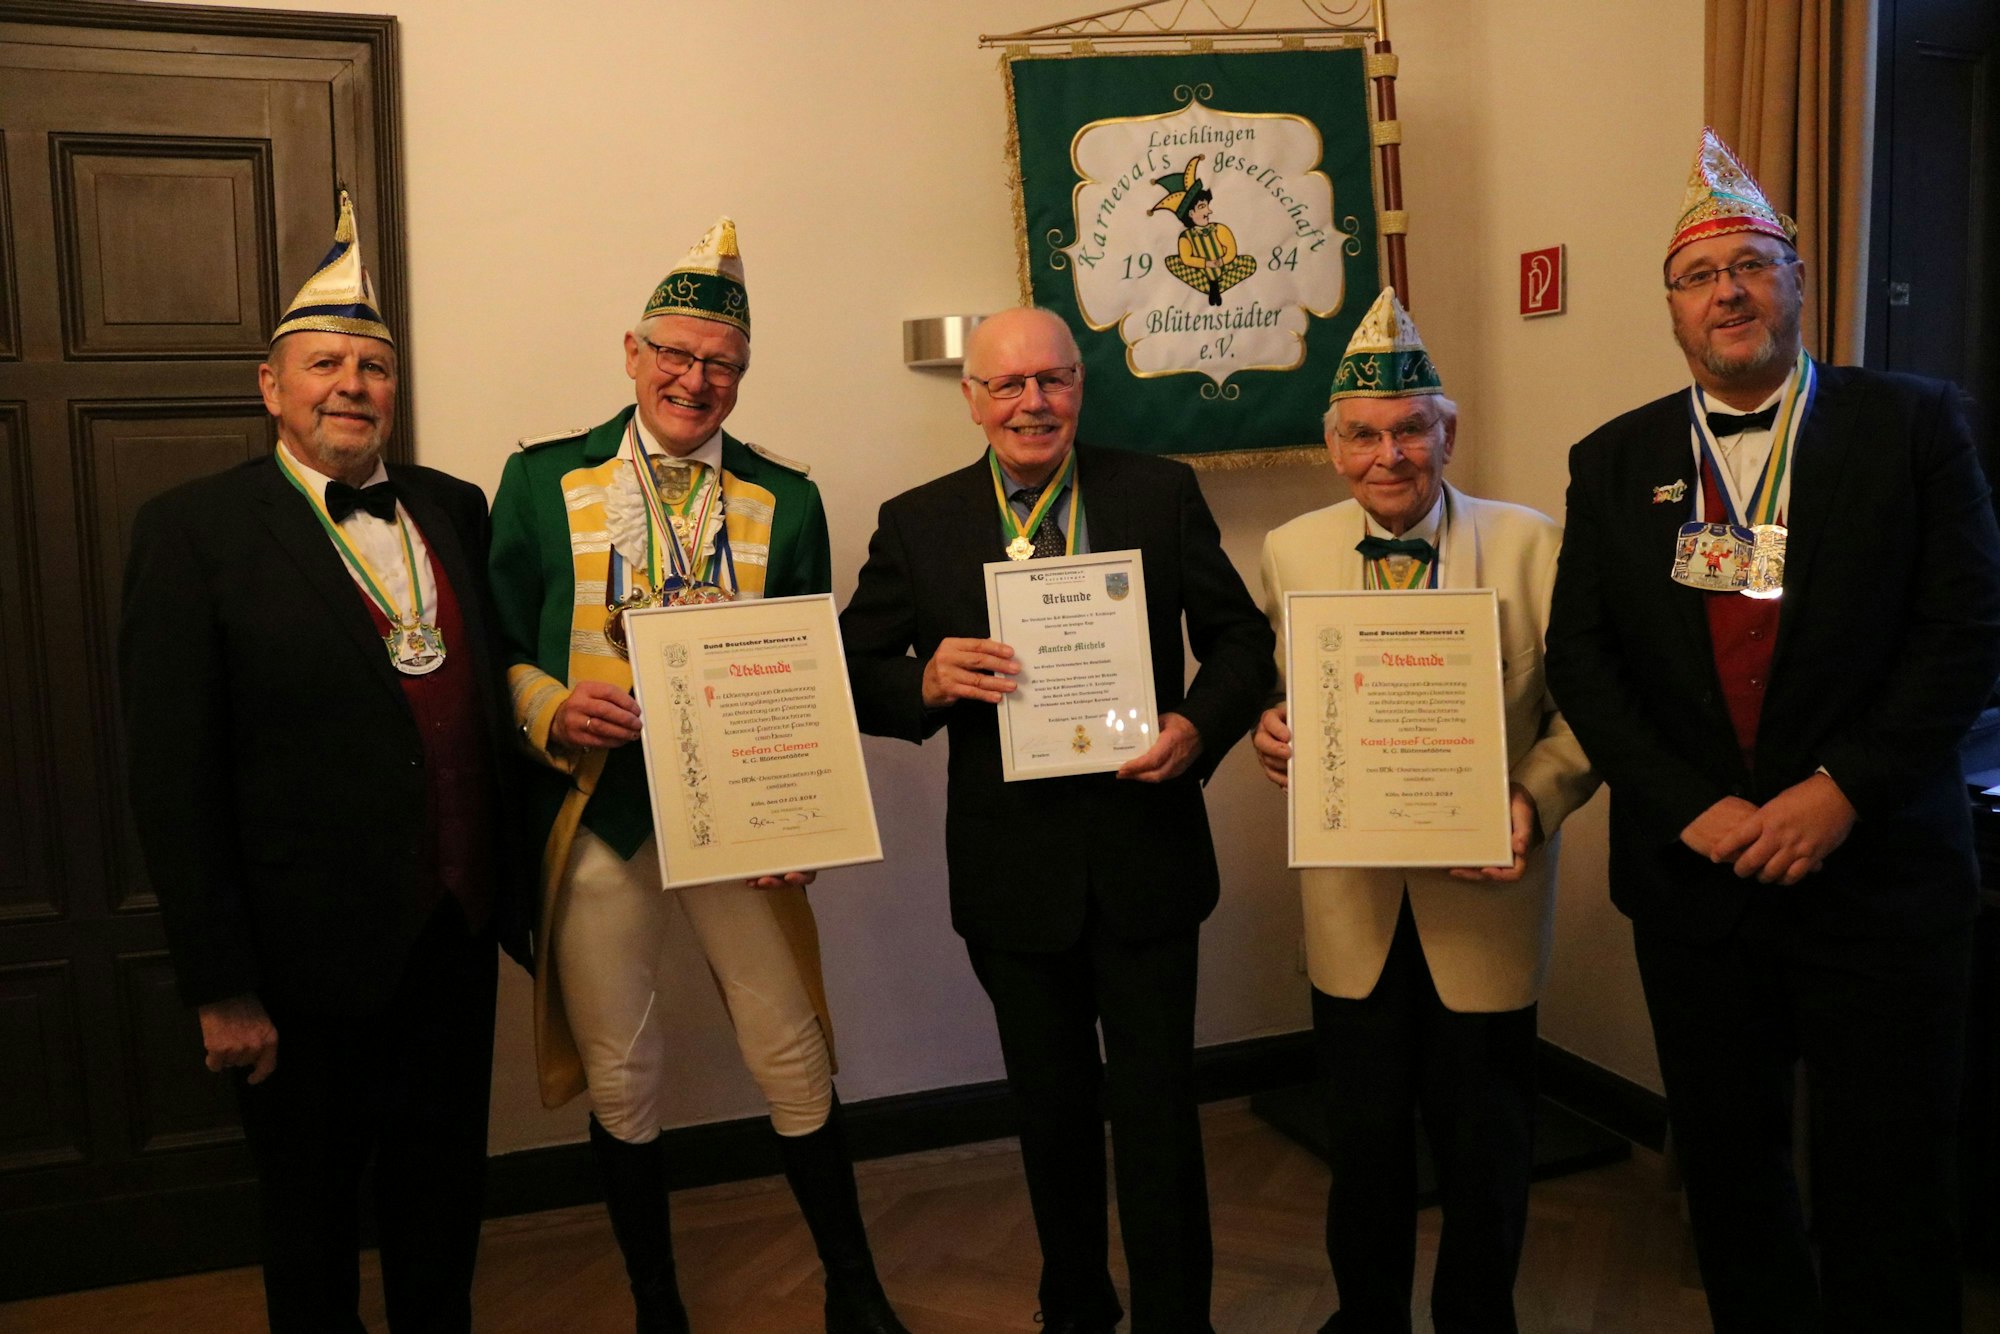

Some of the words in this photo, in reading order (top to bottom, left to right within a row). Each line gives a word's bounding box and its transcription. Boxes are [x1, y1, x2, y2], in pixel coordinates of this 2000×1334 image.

[1149, 125, 1256, 149] Leichlingen
[1078, 150, 1172, 270] Karnevals
[1213, 151, 1328, 253] gesellschaft
[1121, 252, 1154, 281] 19
[1267, 246, 1299, 273] 84
[1146, 300, 1283, 335] Blütenstädter
[1199, 334, 1236, 361] e.V.
[1030, 573, 1044, 582] KG
[1042, 591, 1092, 605] Urkunde
[725, 640, 762, 648] Deutscher
[763, 636, 796, 644] Karneval
[1038, 643, 1072, 655] Manfred
[1074, 640, 1106, 652] Michels
[1381, 652, 1445, 667] Urkunde
[729, 661, 792, 677] Urkunde
[731, 745, 772, 758] Stefan
[774, 741, 819, 753] Clemen
[1360, 736, 1420, 747] Karl-Josef
[1422, 736, 1475, 746] Conrads
